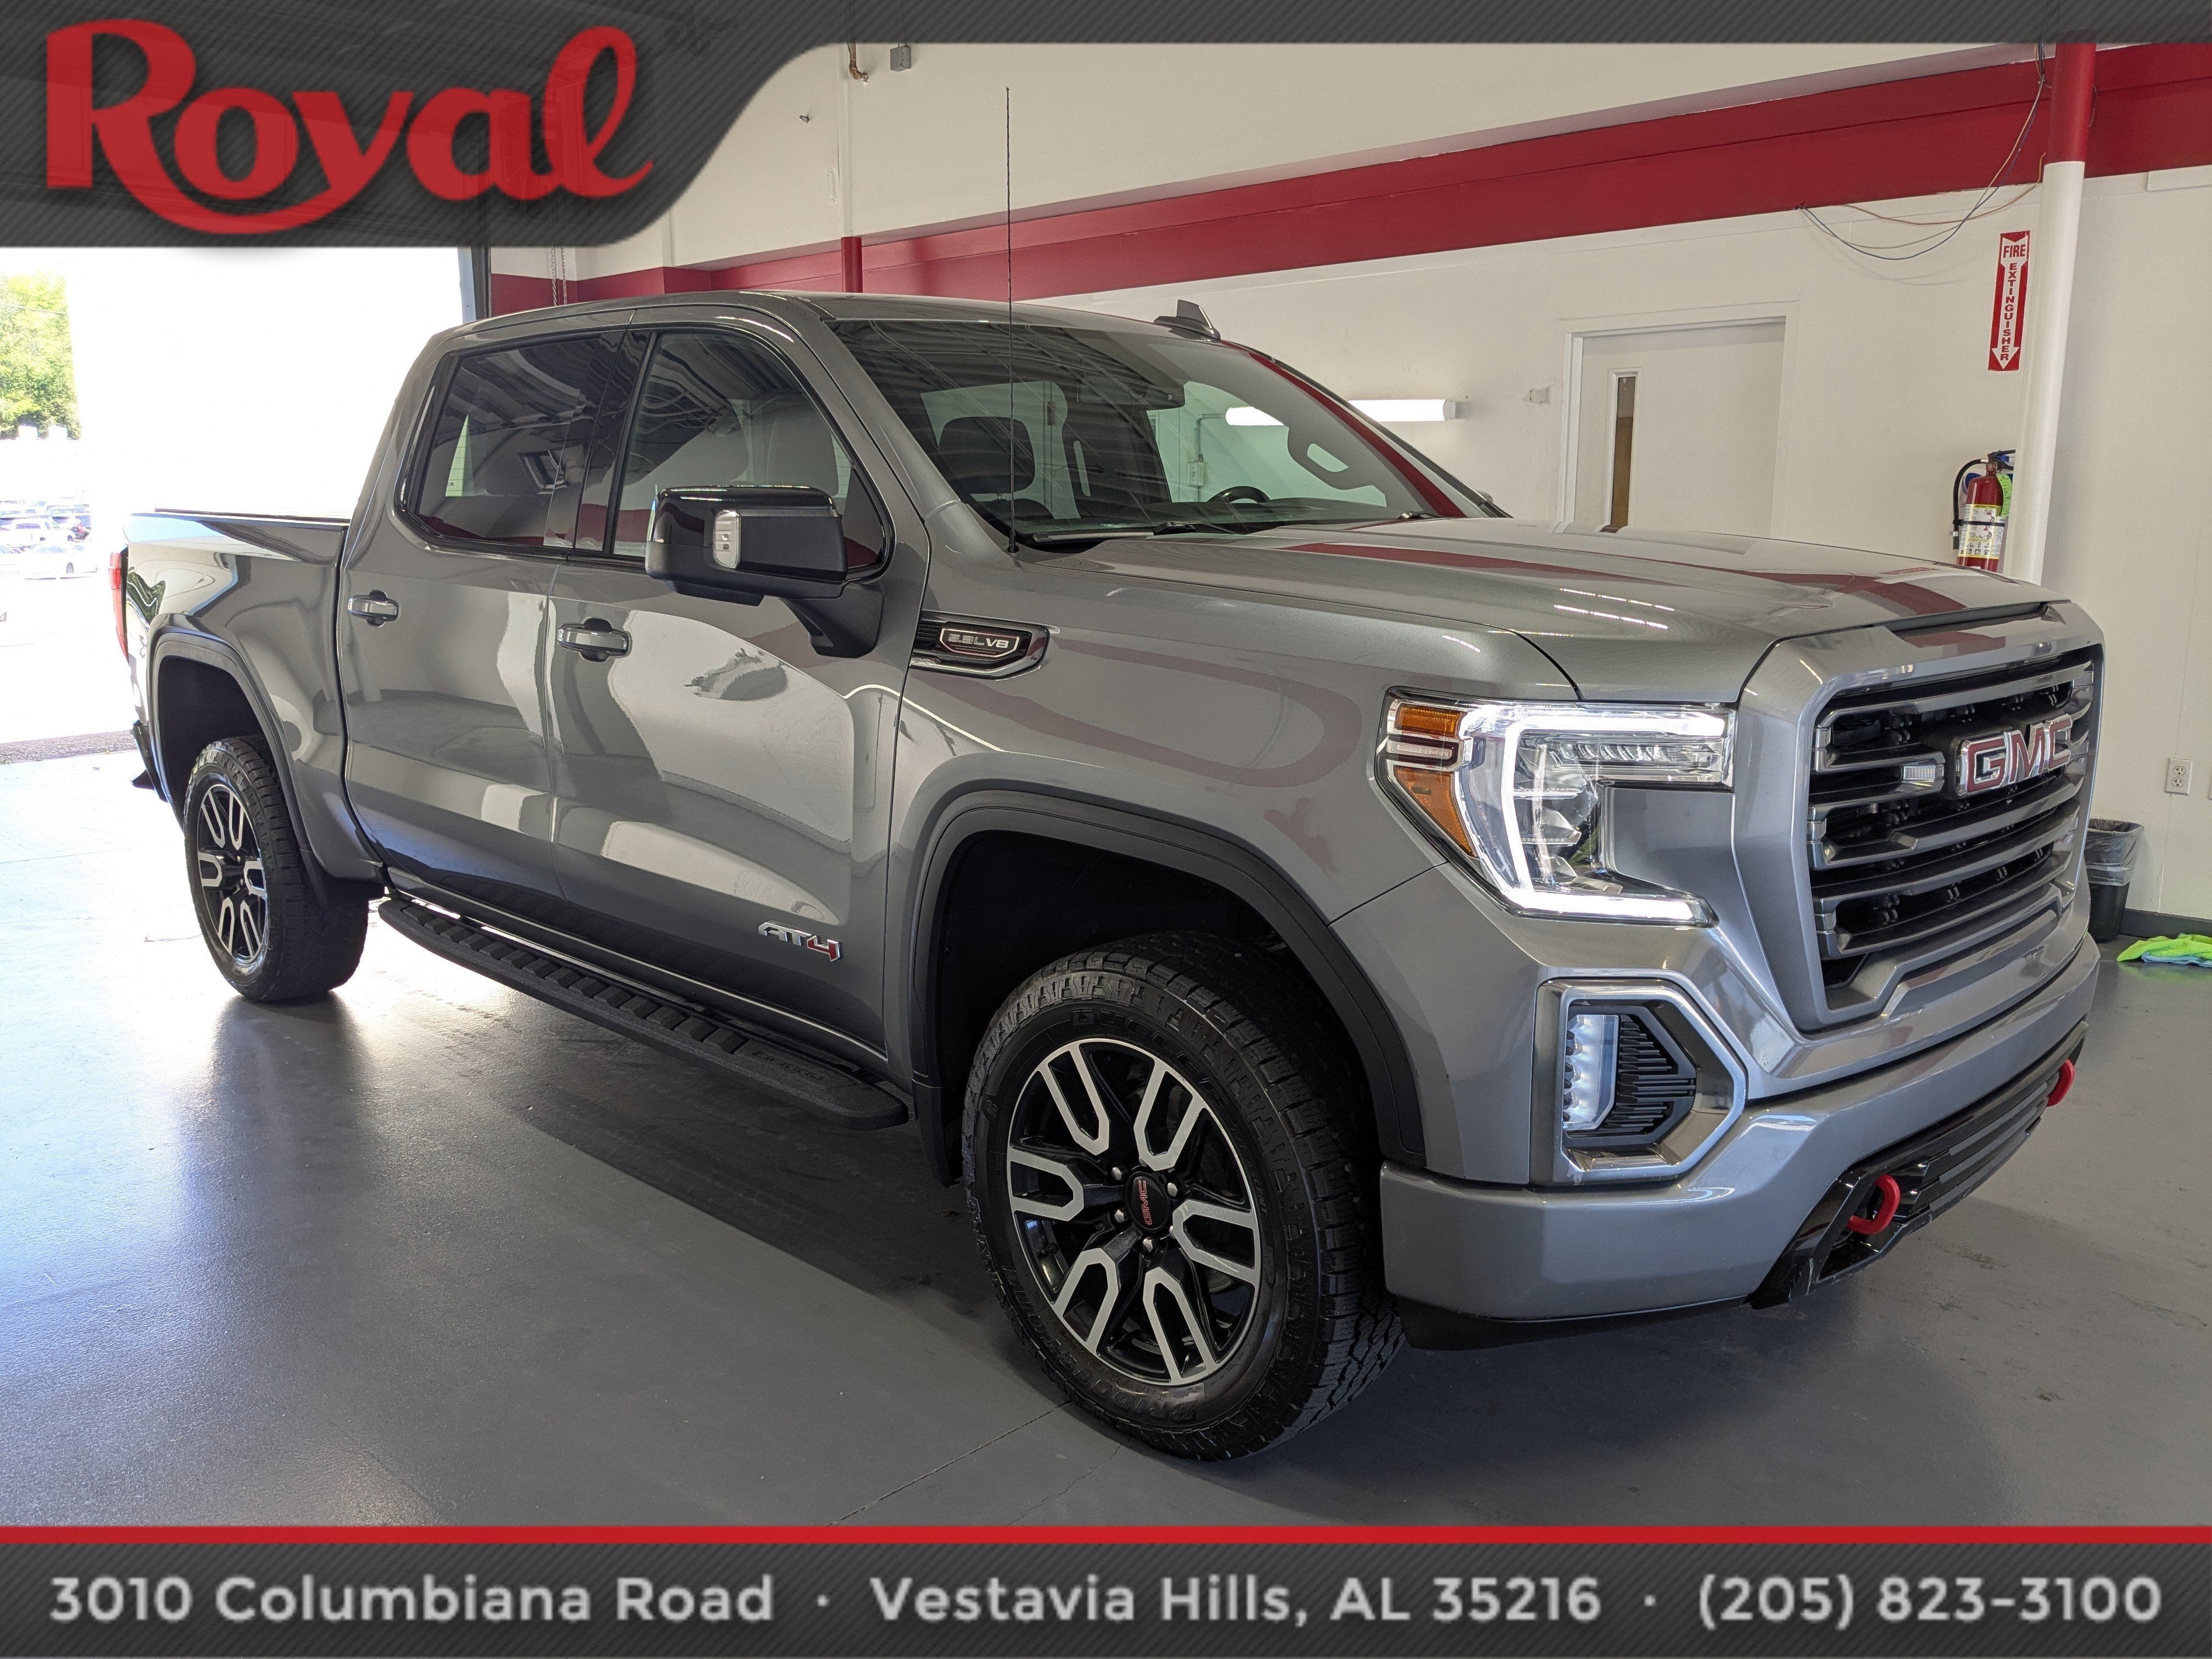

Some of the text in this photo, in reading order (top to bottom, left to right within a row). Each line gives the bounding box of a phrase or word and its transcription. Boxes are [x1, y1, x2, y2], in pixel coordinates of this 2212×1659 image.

[2002, 244, 2027, 259] FIRE
[2000, 262, 2018, 362] EXTINGUISHER
[1961, 713, 2073, 795] GMC
[758, 921, 843, 962] AT4
[1138, 1180, 1153, 1226] GMC
